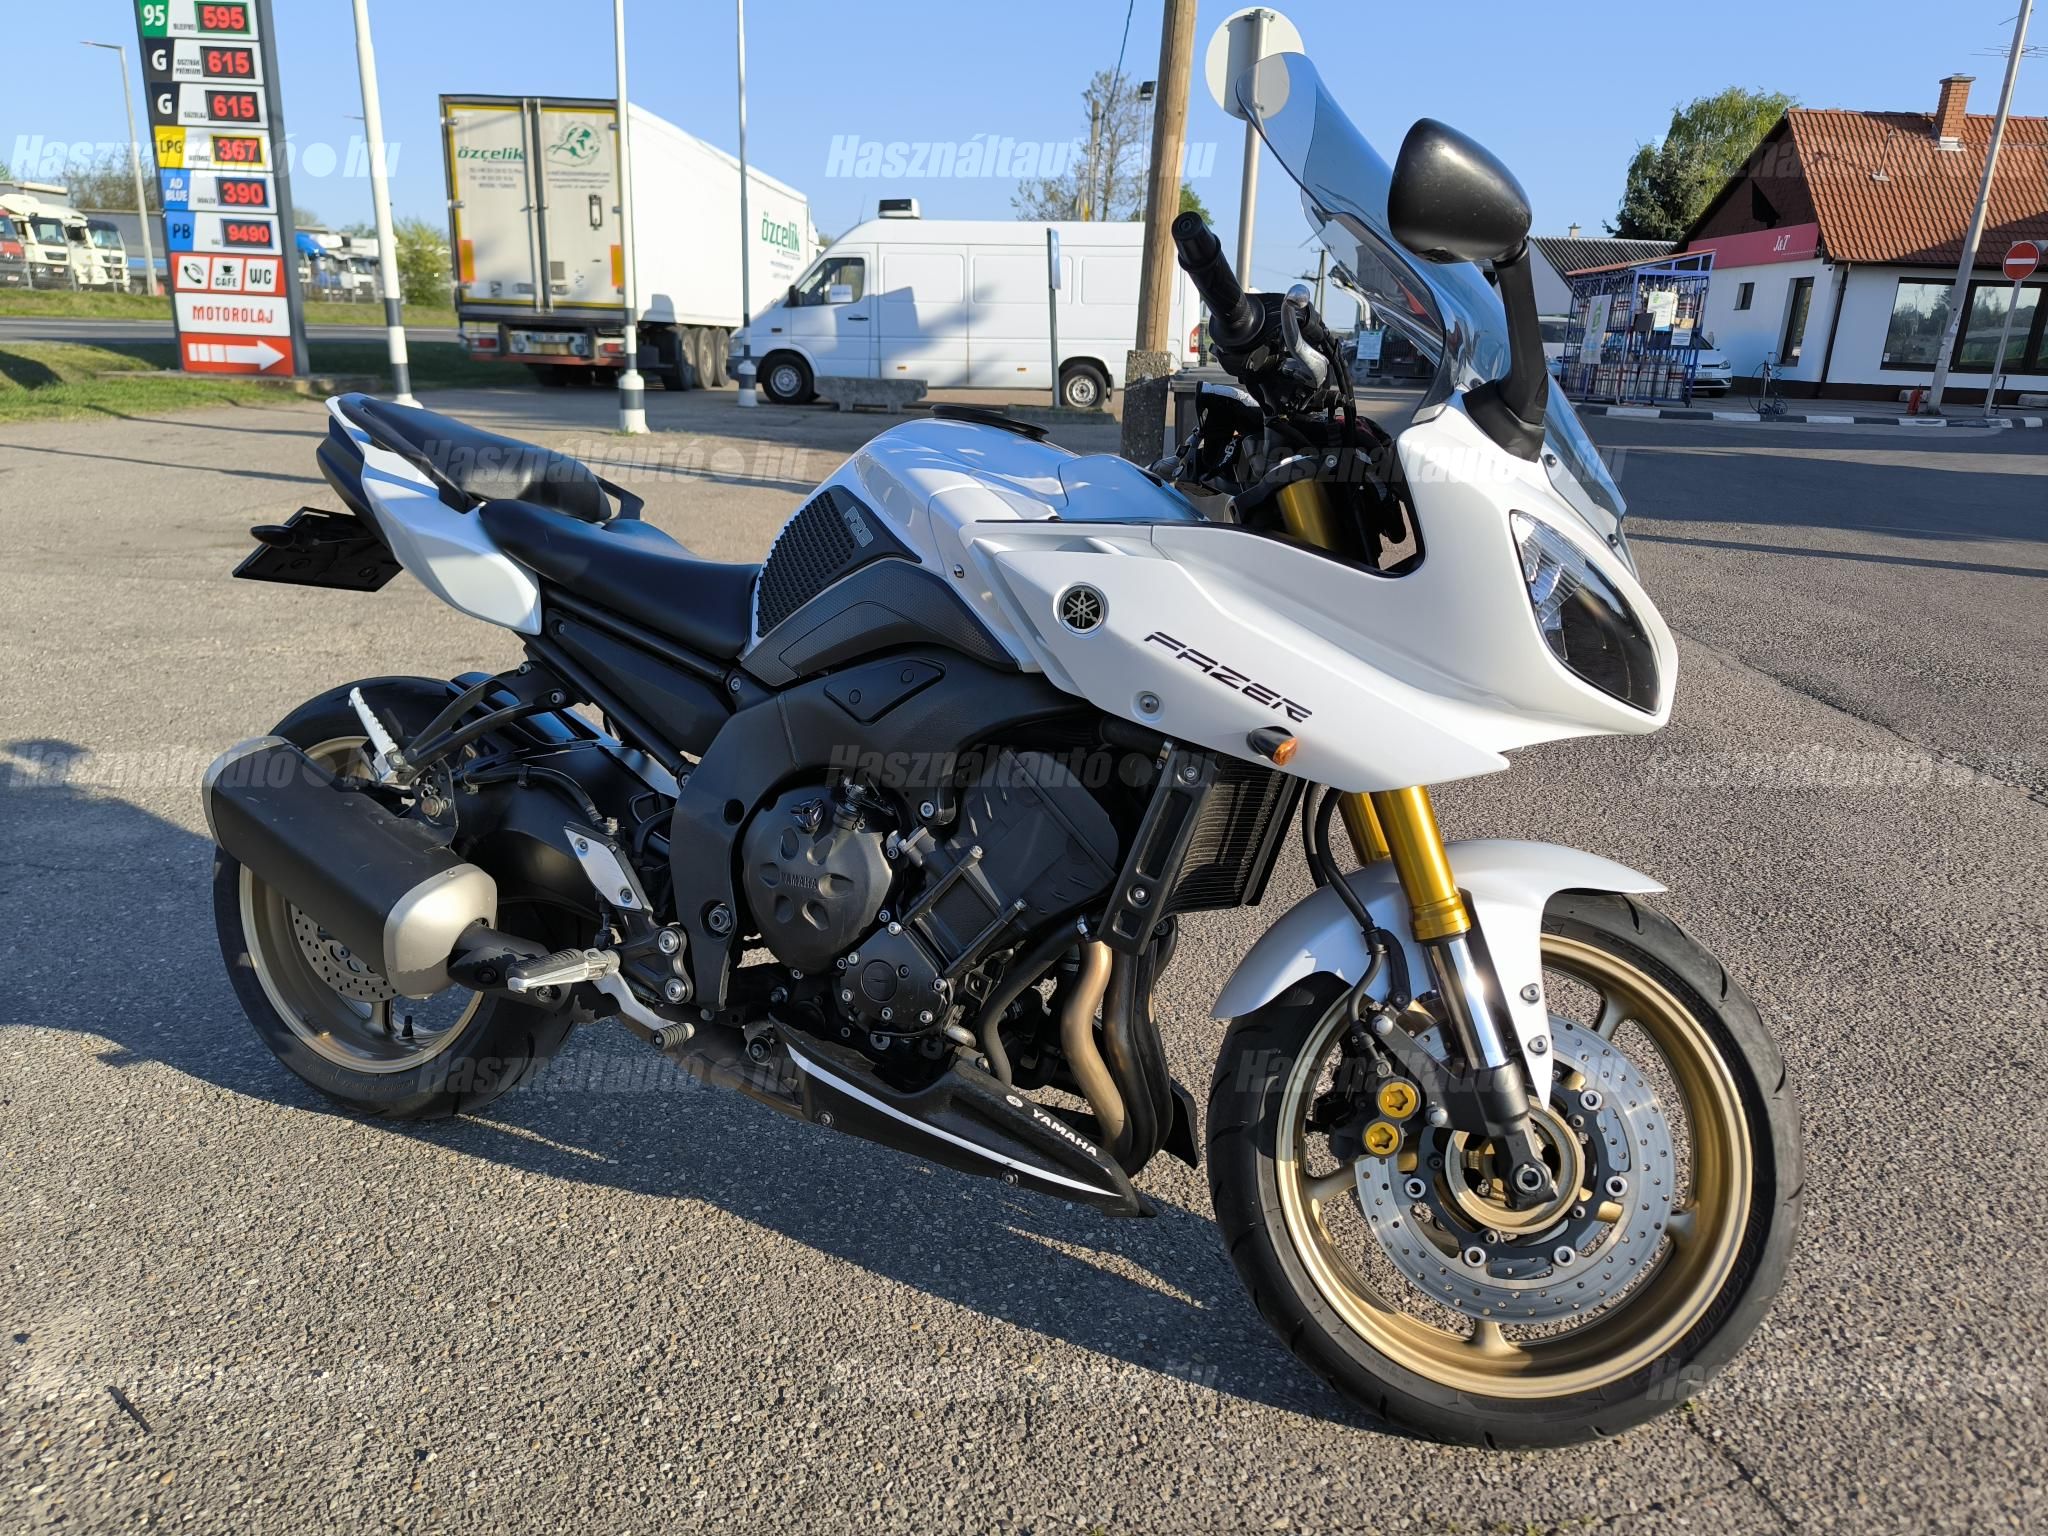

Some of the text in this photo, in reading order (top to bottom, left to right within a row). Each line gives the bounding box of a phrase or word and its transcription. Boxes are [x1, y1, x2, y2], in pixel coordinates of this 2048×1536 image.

[143, 5, 166, 26] 95
[203, 6, 245, 29] 595
[152, 49, 167, 71] G
[208, 50, 250, 74] 615
[157, 93, 173, 114] G
[213, 95, 255, 118] 615
[160, 139, 183, 154] LPG
[218, 139, 257, 161] 367
[169, 178, 184, 188] AD
[223, 182, 264, 204] 390
[165, 190, 188, 202] BLUE
[172, 224, 191, 239] PB
[228, 224, 269, 242] 9490
[215, 277, 237, 287] CAFE
[249, 268, 272, 285] WC
[192, 305, 274, 323] MOTOROLAJ
[1144, 632, 1313, 723] FAZER
[1033, 1108, 1097, 1157] YAMAHA
